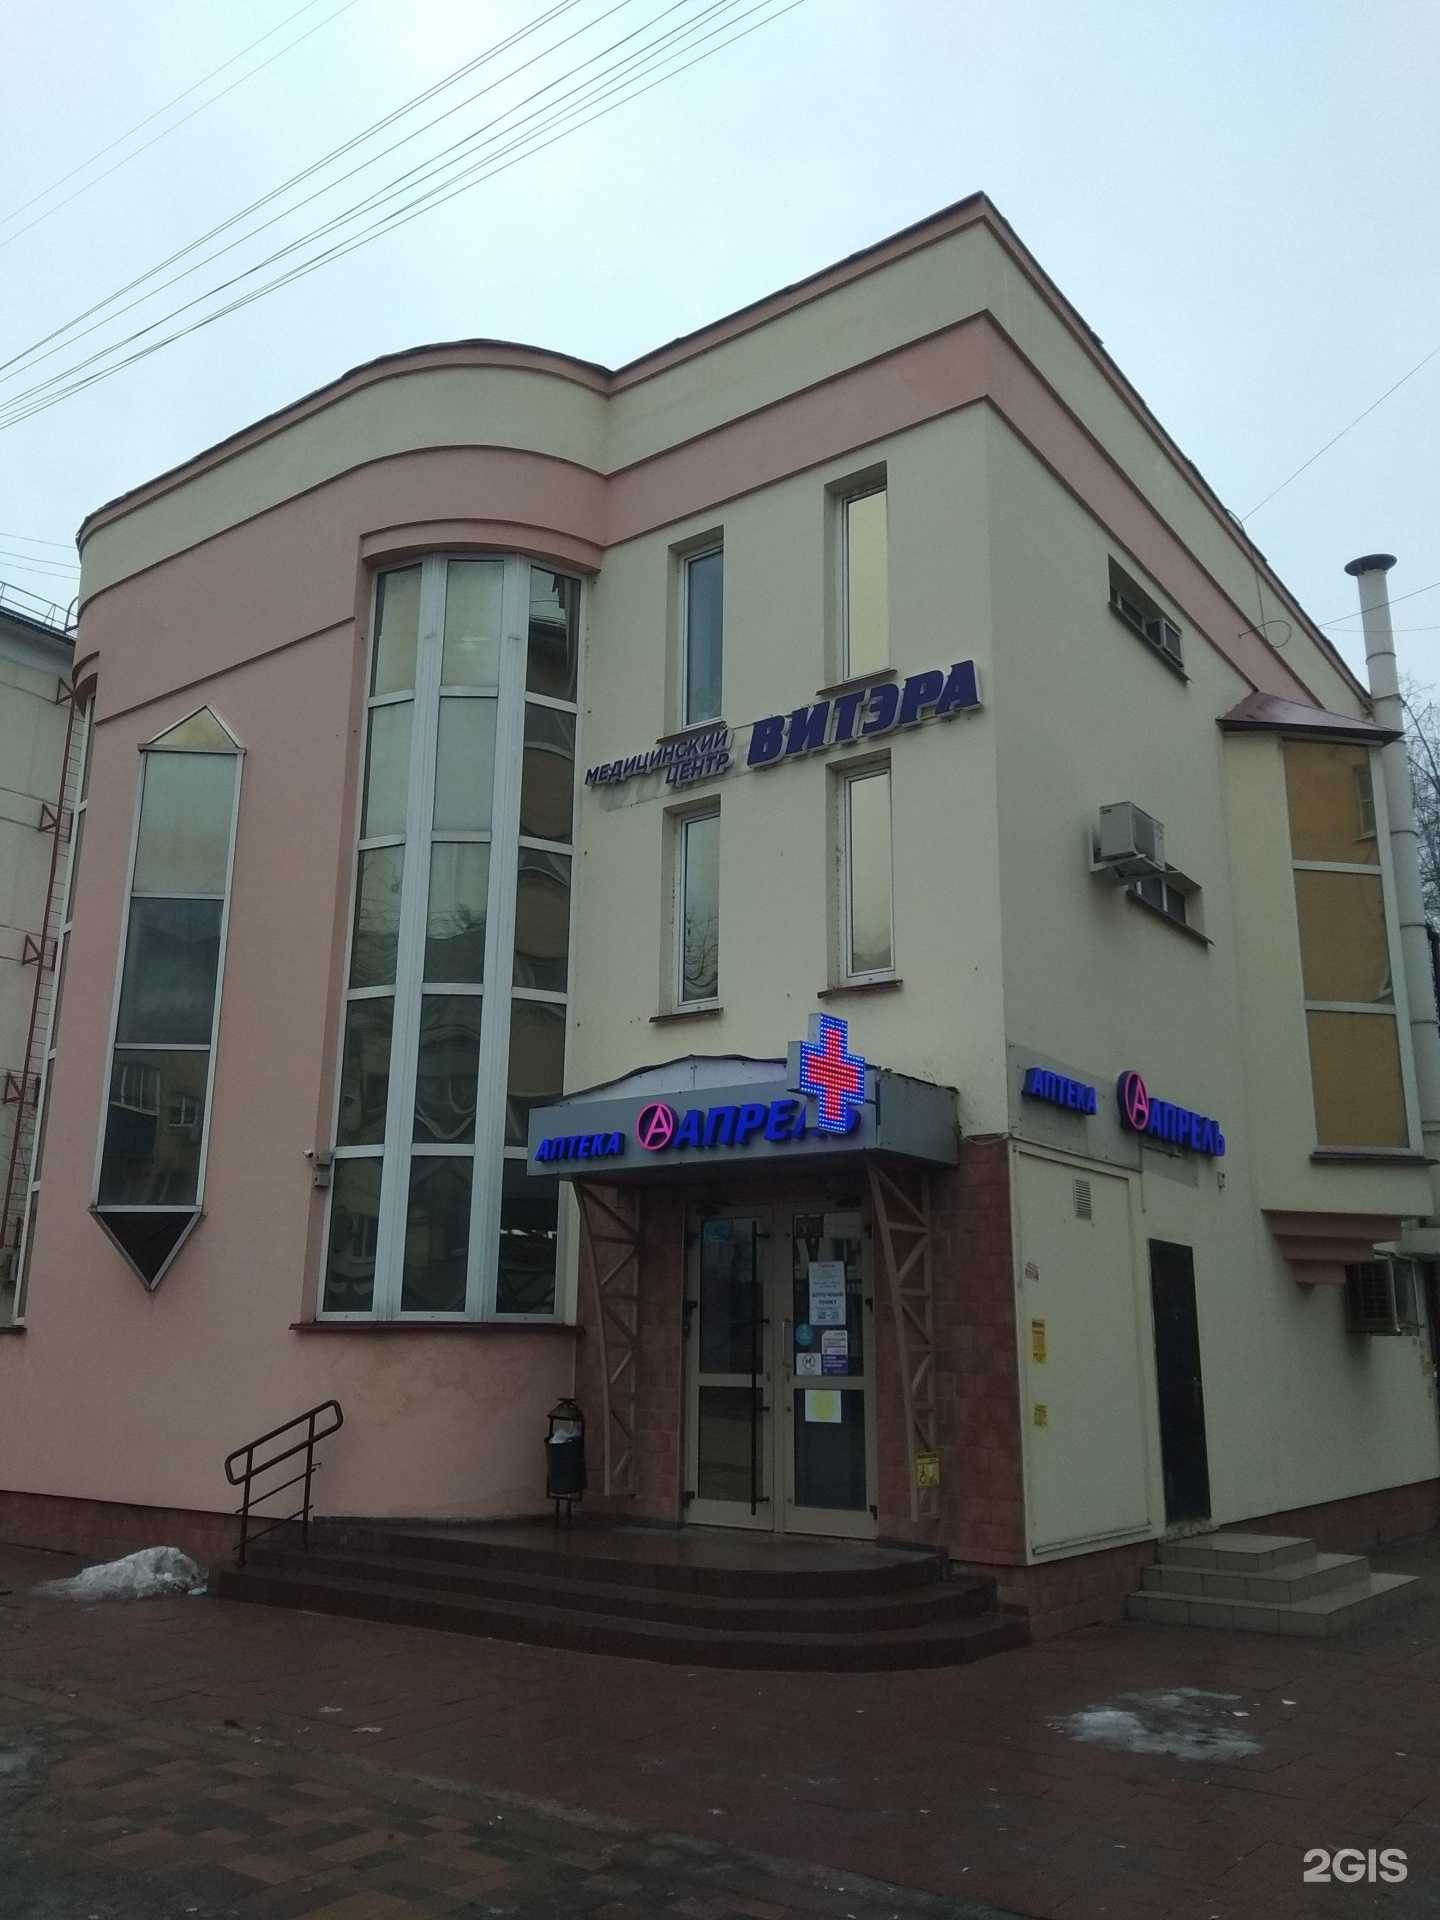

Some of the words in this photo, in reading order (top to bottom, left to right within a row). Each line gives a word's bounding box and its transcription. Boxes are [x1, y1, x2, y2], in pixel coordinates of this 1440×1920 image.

[746, 659, 981, 768] ВИТЭРА
[584, 726, 729, 785] МЕДИЦИНСКИЙ
[665, 751, 730, 785] ЦЕНТР
[535, 1131, 626, 1163] АПТЕКА
[672, 1099, 861, 1149] АПРЕ
[1022, 1067, 1097, 1115] АПТЕКА
[1147, 1097, 1226, 1157] АПРЕЛЬ
